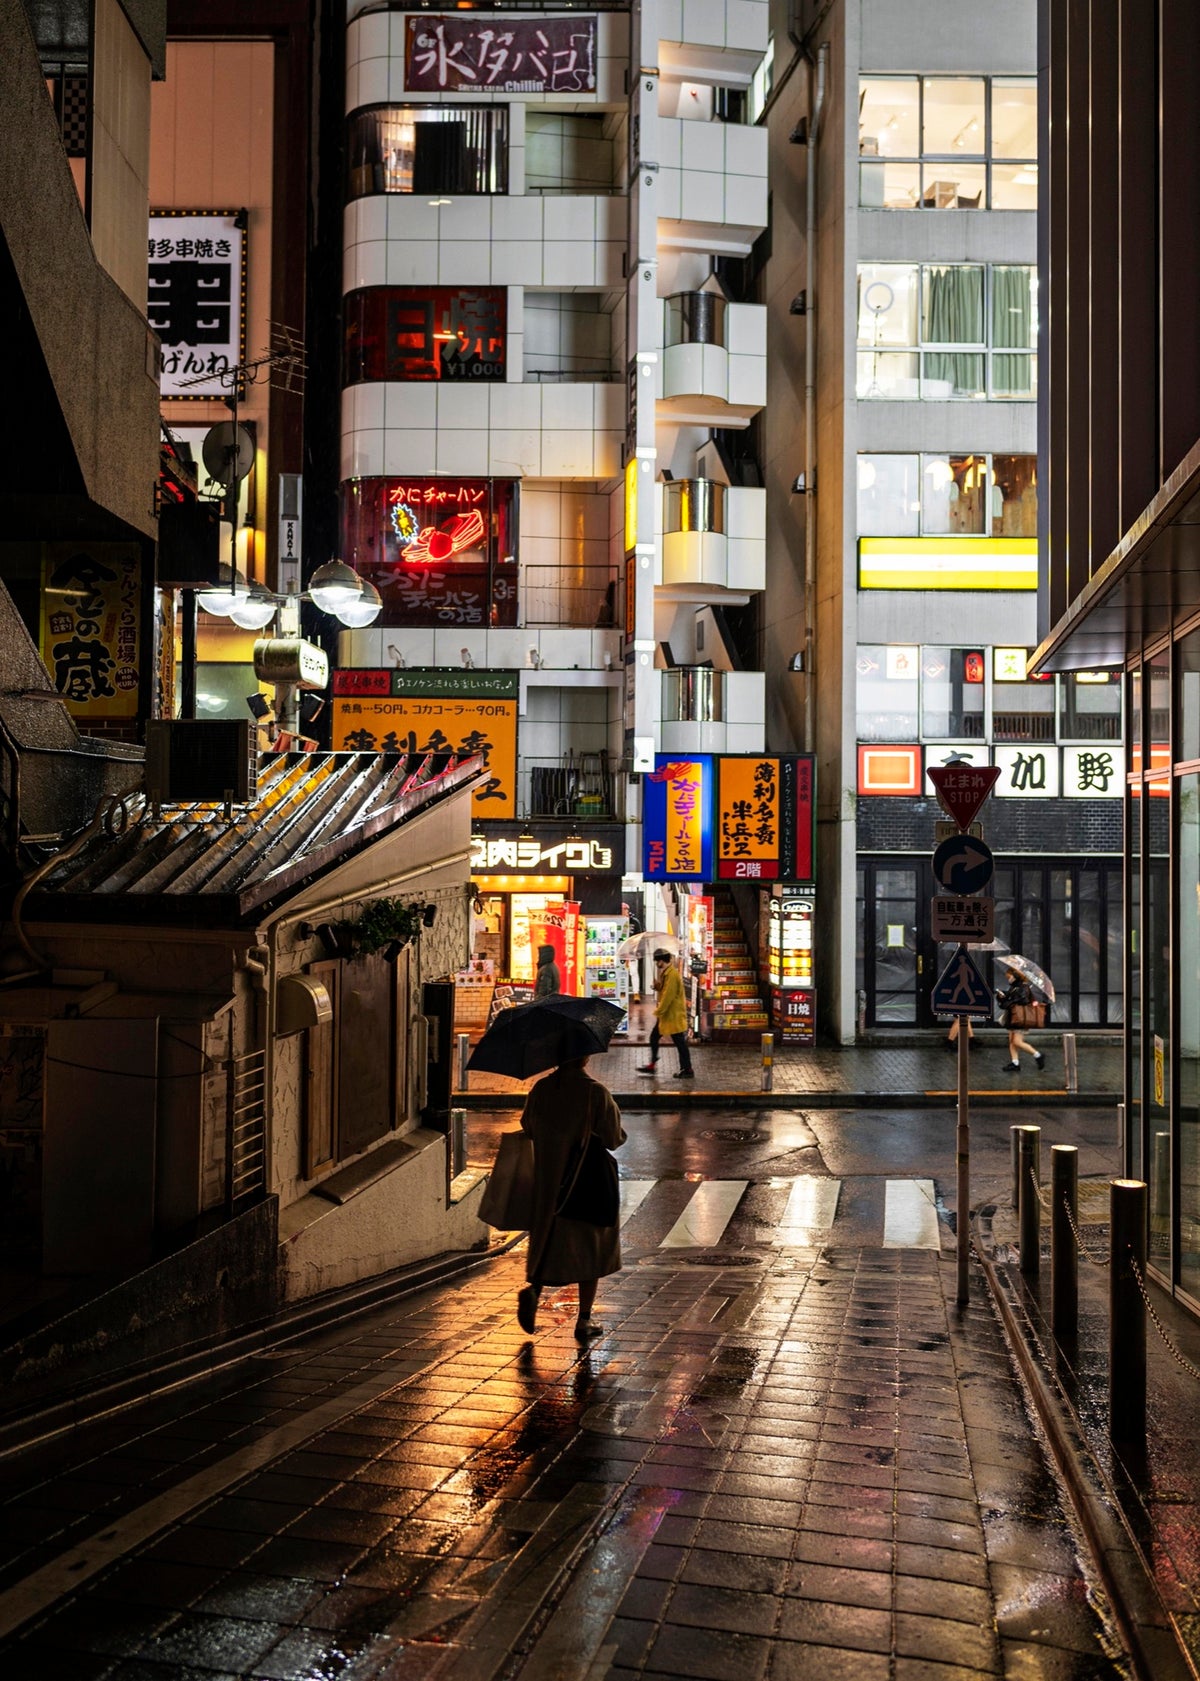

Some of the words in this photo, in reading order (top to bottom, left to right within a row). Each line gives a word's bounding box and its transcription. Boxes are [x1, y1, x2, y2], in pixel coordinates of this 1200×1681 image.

[417, 34, 437, 48] 6F
[389, 486, 484, 502] かにチャーハン
[494, 579, 516, 600] 3F
[117, 556, 137, 663] きんくら酒場
[943, 774, 985, 788] 止まれ
[950, 792, 980, 804] STOP
[649, 841, 664, 872] 3F
[735, 862, 761, 877] 2階
[937, 901, 988, 913] 自転車を除く
[938, 915, 988, 927] 一方通行
[788, 1003, 810, 1015] 日焼
